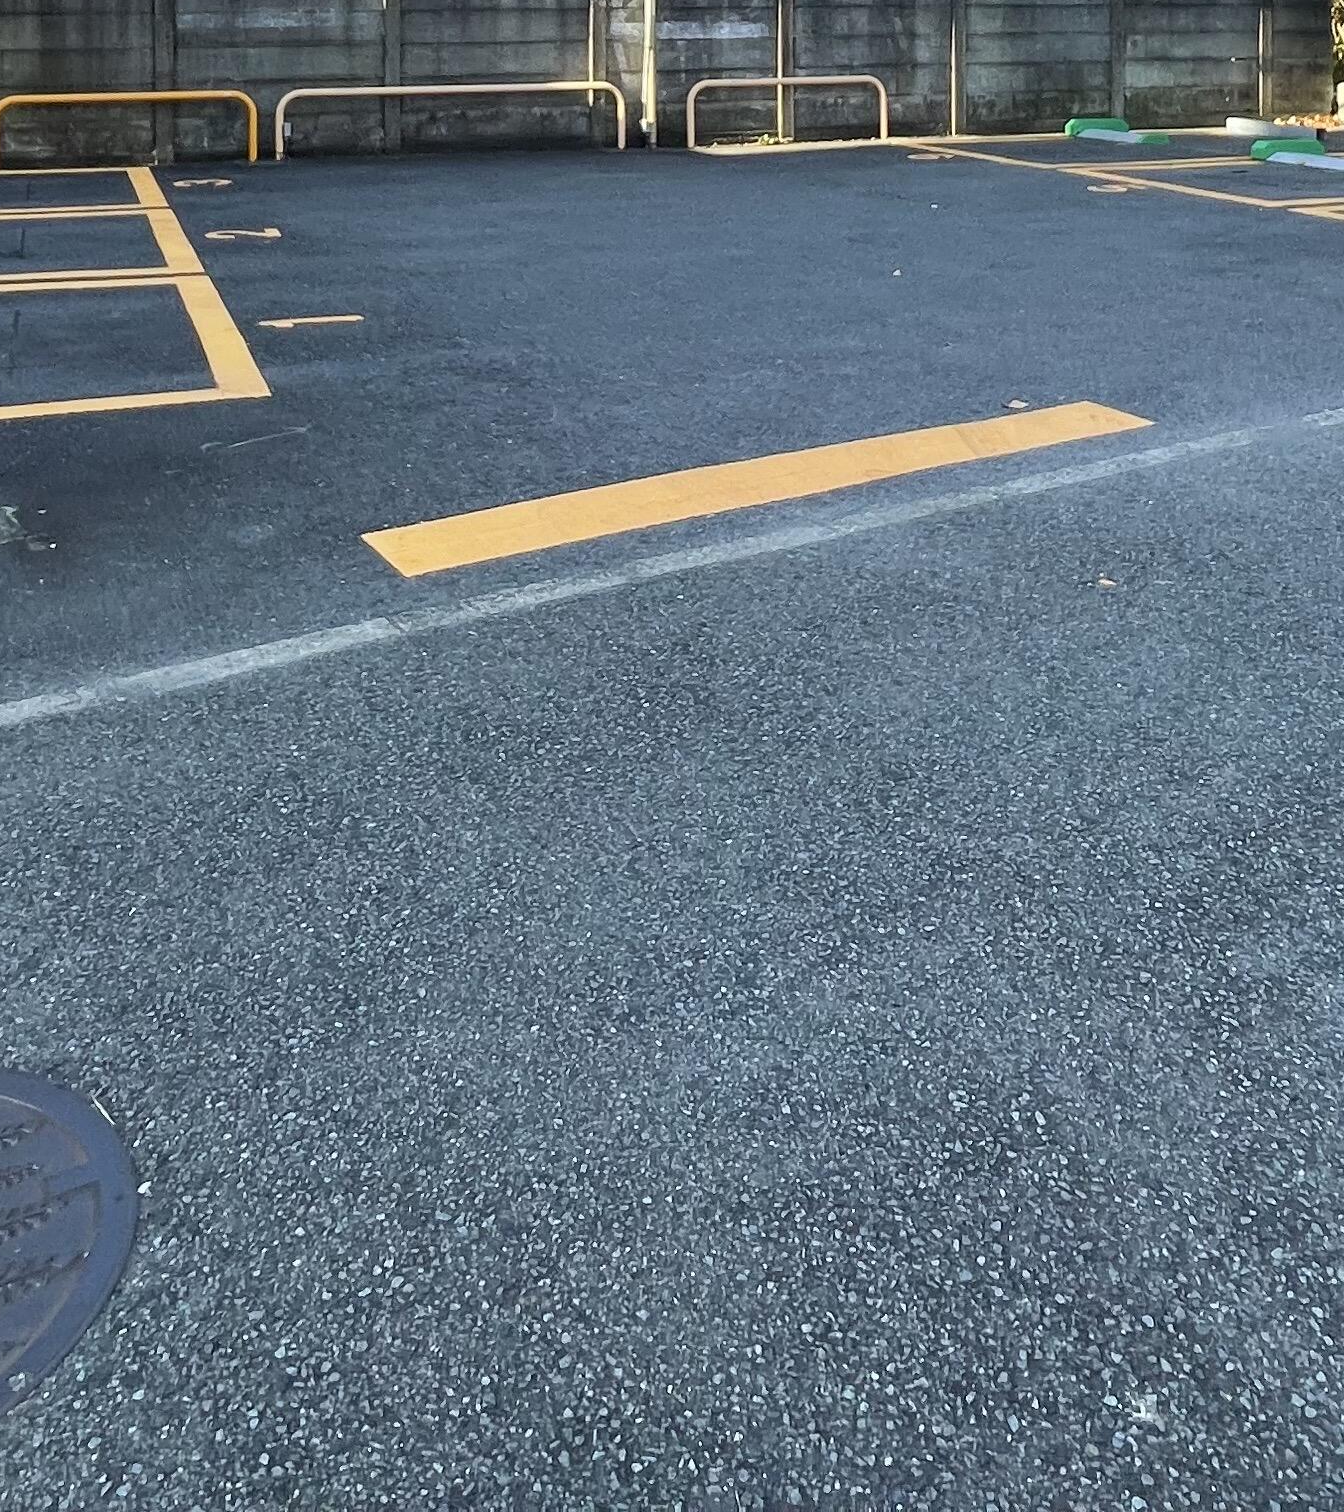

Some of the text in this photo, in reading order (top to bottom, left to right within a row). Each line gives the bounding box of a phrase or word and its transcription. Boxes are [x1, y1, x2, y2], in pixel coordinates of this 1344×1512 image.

[173, 178, 233, 187] 3
[205, 227, 282, 239] 2
[257, 314, 365, 328] 1
